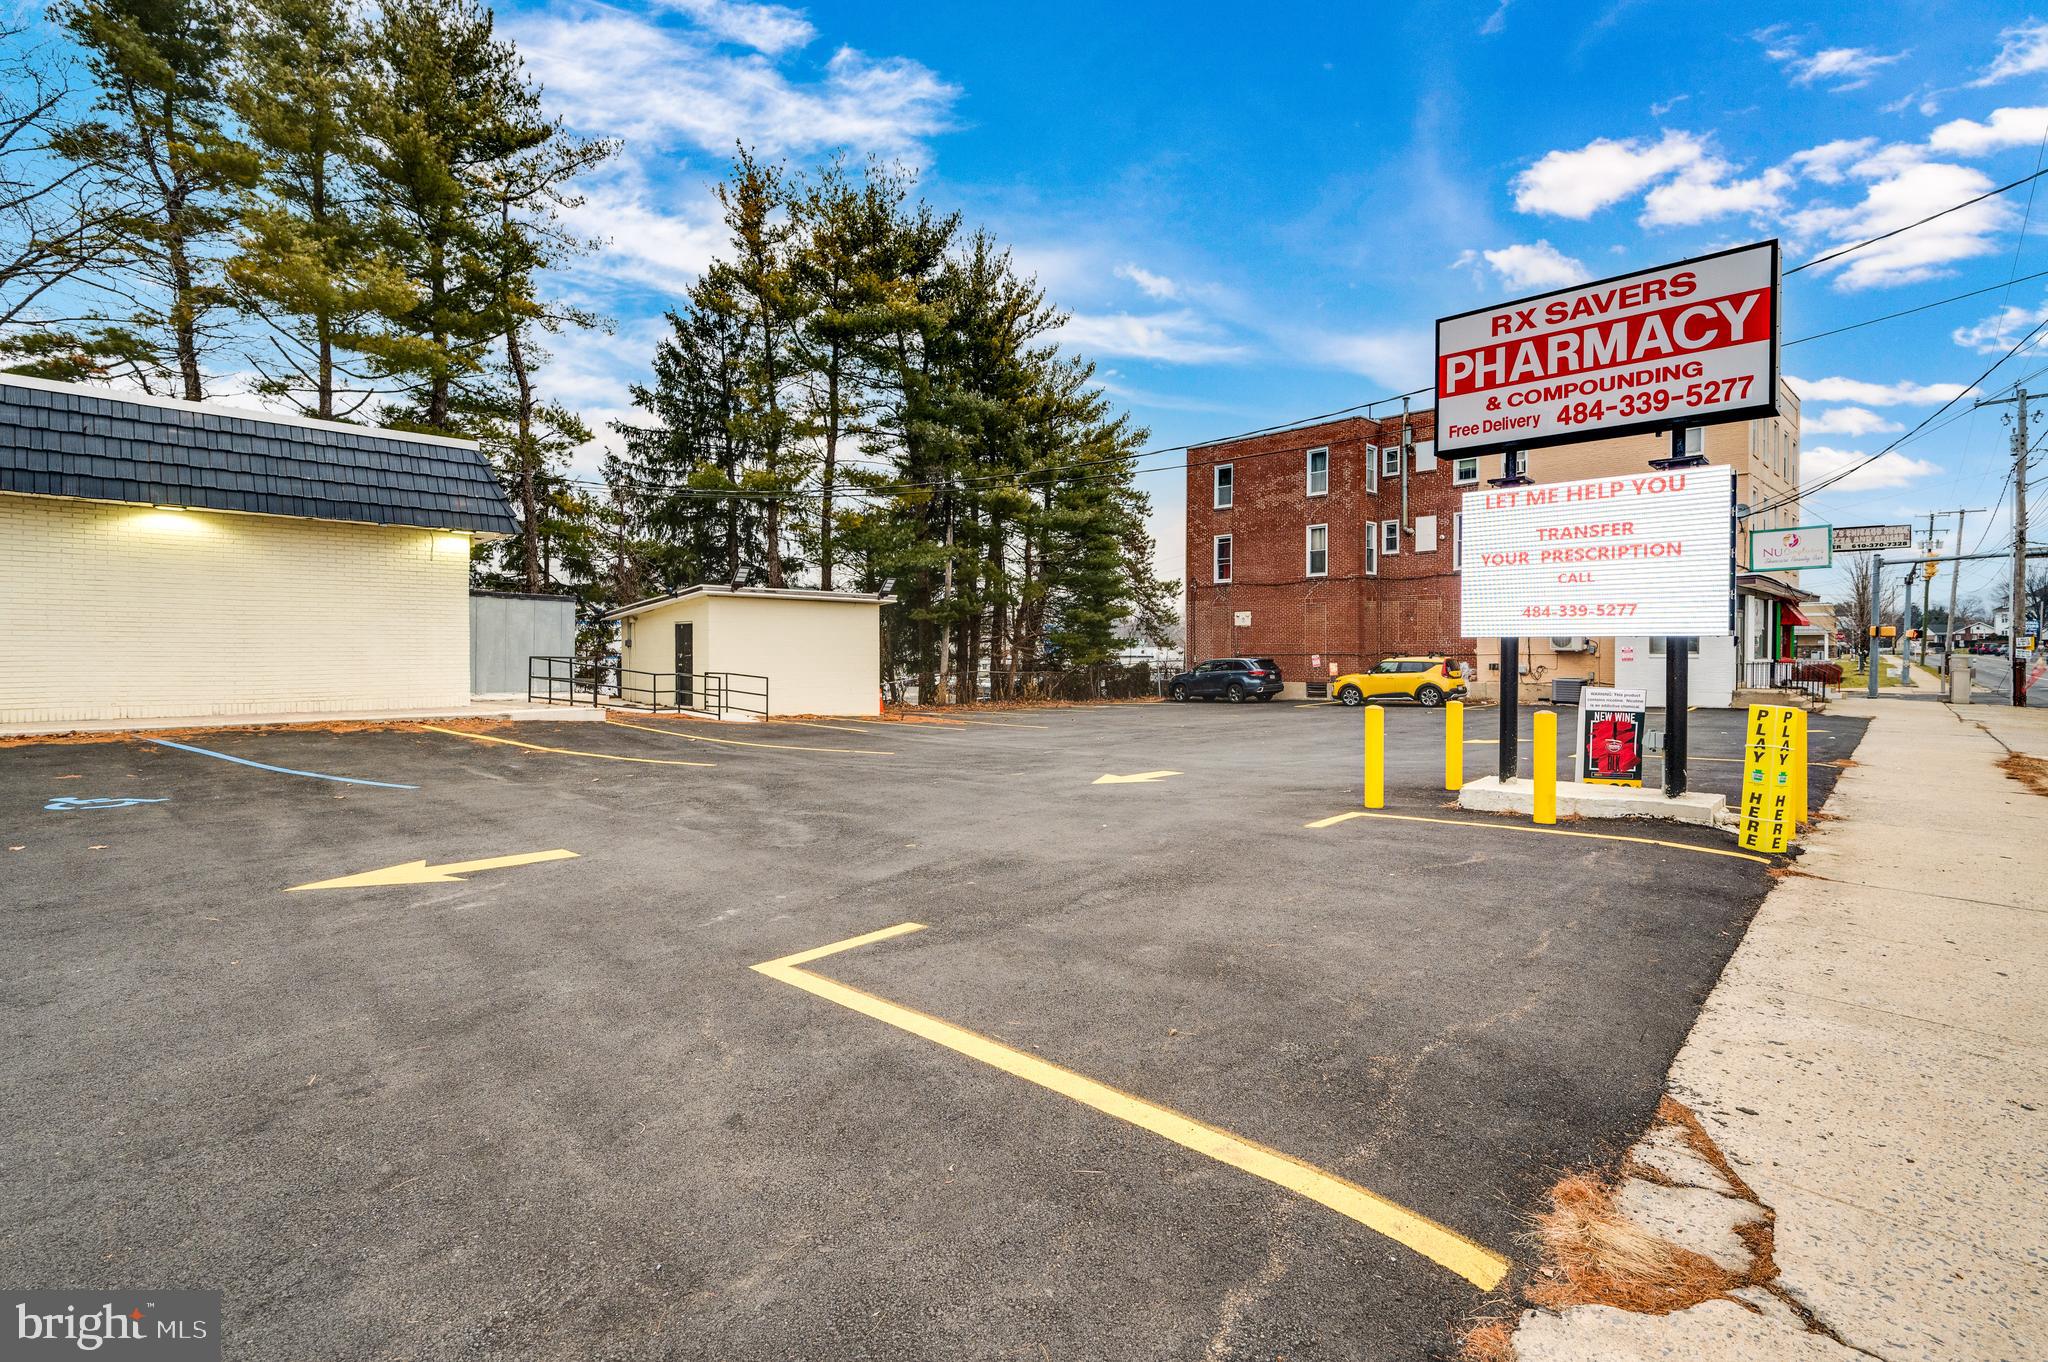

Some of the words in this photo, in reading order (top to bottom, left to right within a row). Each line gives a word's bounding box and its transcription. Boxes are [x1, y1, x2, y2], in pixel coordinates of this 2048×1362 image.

[1491, 307, 1537, 337] RX
[1545, 271, 1697, 325] SAVERS
[1446, 294, 1760, 394] PHARMACY
[1485, 396, 1502, 411] &
[1507, 361, 1704, 407] COMPOUNDING
[1556, 375, 1755, 426] 484-339-5277
[1449, 425, 1480, 438] Free
[1482, 414, 1541, 433] Delivery
[1485, 491, 1520, 510] LET
[1526, 487, 1559, 506] ME
[1566, 481, 1625, 502] HELP
[1631, 474, 1687, 495] YOU
[1480, 551, 1530, 567] YOUR
[1540, 541, 1683, 563] PRESCRIPTION
[1536, 521, 1635, 541] TRANSFER
[1557, 571, 1596, 584] CALL
[1522, 603, 1639, 618] 484-339-5277
[1594, 711, 1613, 722] NEW
[1614, 712, 1636, 723] WINE
[1754, 709, 1769, 763] PLAY
[1779, 711, 1793, 766] PLAY
[1746, 791, 1763, 847] HERE
[1771, 795, 1786, 849] HERE
